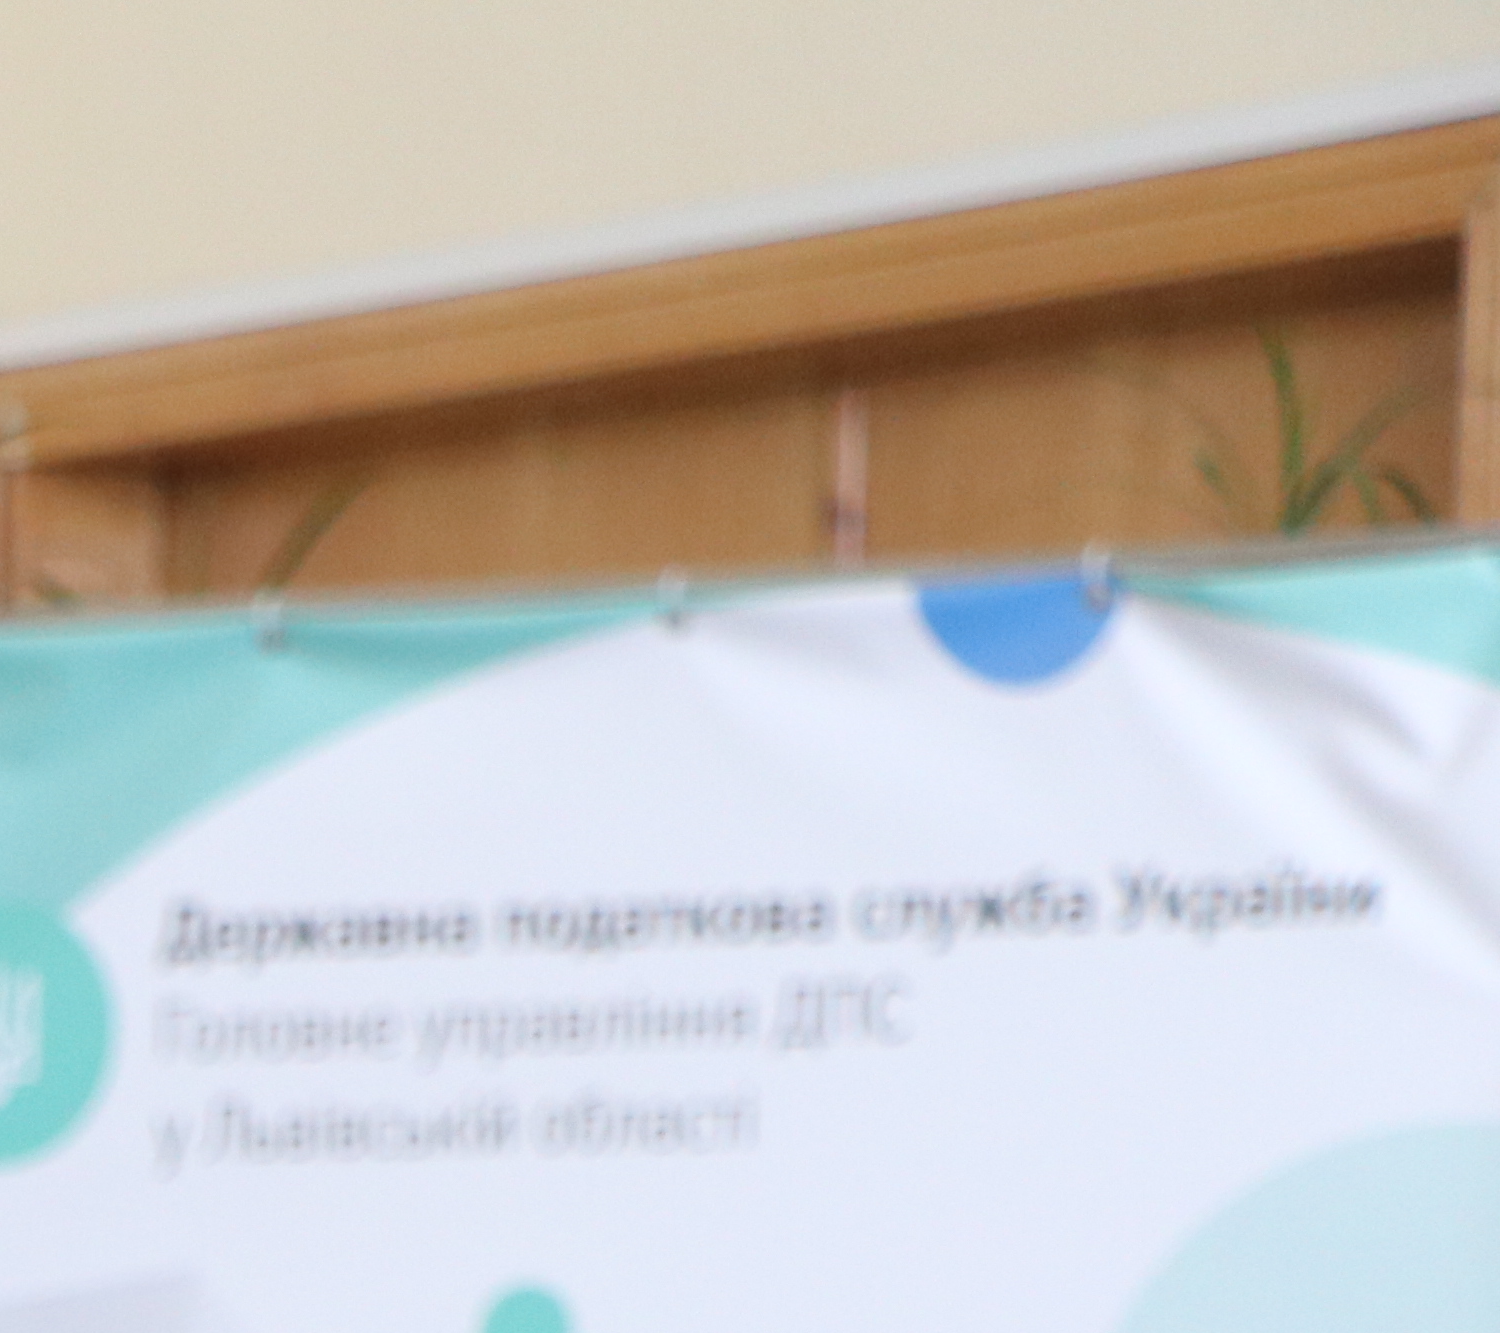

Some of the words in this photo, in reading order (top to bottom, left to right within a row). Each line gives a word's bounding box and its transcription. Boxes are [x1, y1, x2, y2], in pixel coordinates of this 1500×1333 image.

[160, 894, 478, 968] Державна
[497, 886, 832, 957] податкова
[855, 867, 1095, 950] служба
[1111, 862, 1382, 944] України
[154, 1000, 400, 1061] Головне
[416, 991, 755, 1068] управління
[770, 972, 913, 1052] ДПС
[150, 1112, 192, 1182] у
[206, 1092, 520, 1164] Львівській
[529, 1090, 761, 1157] області
